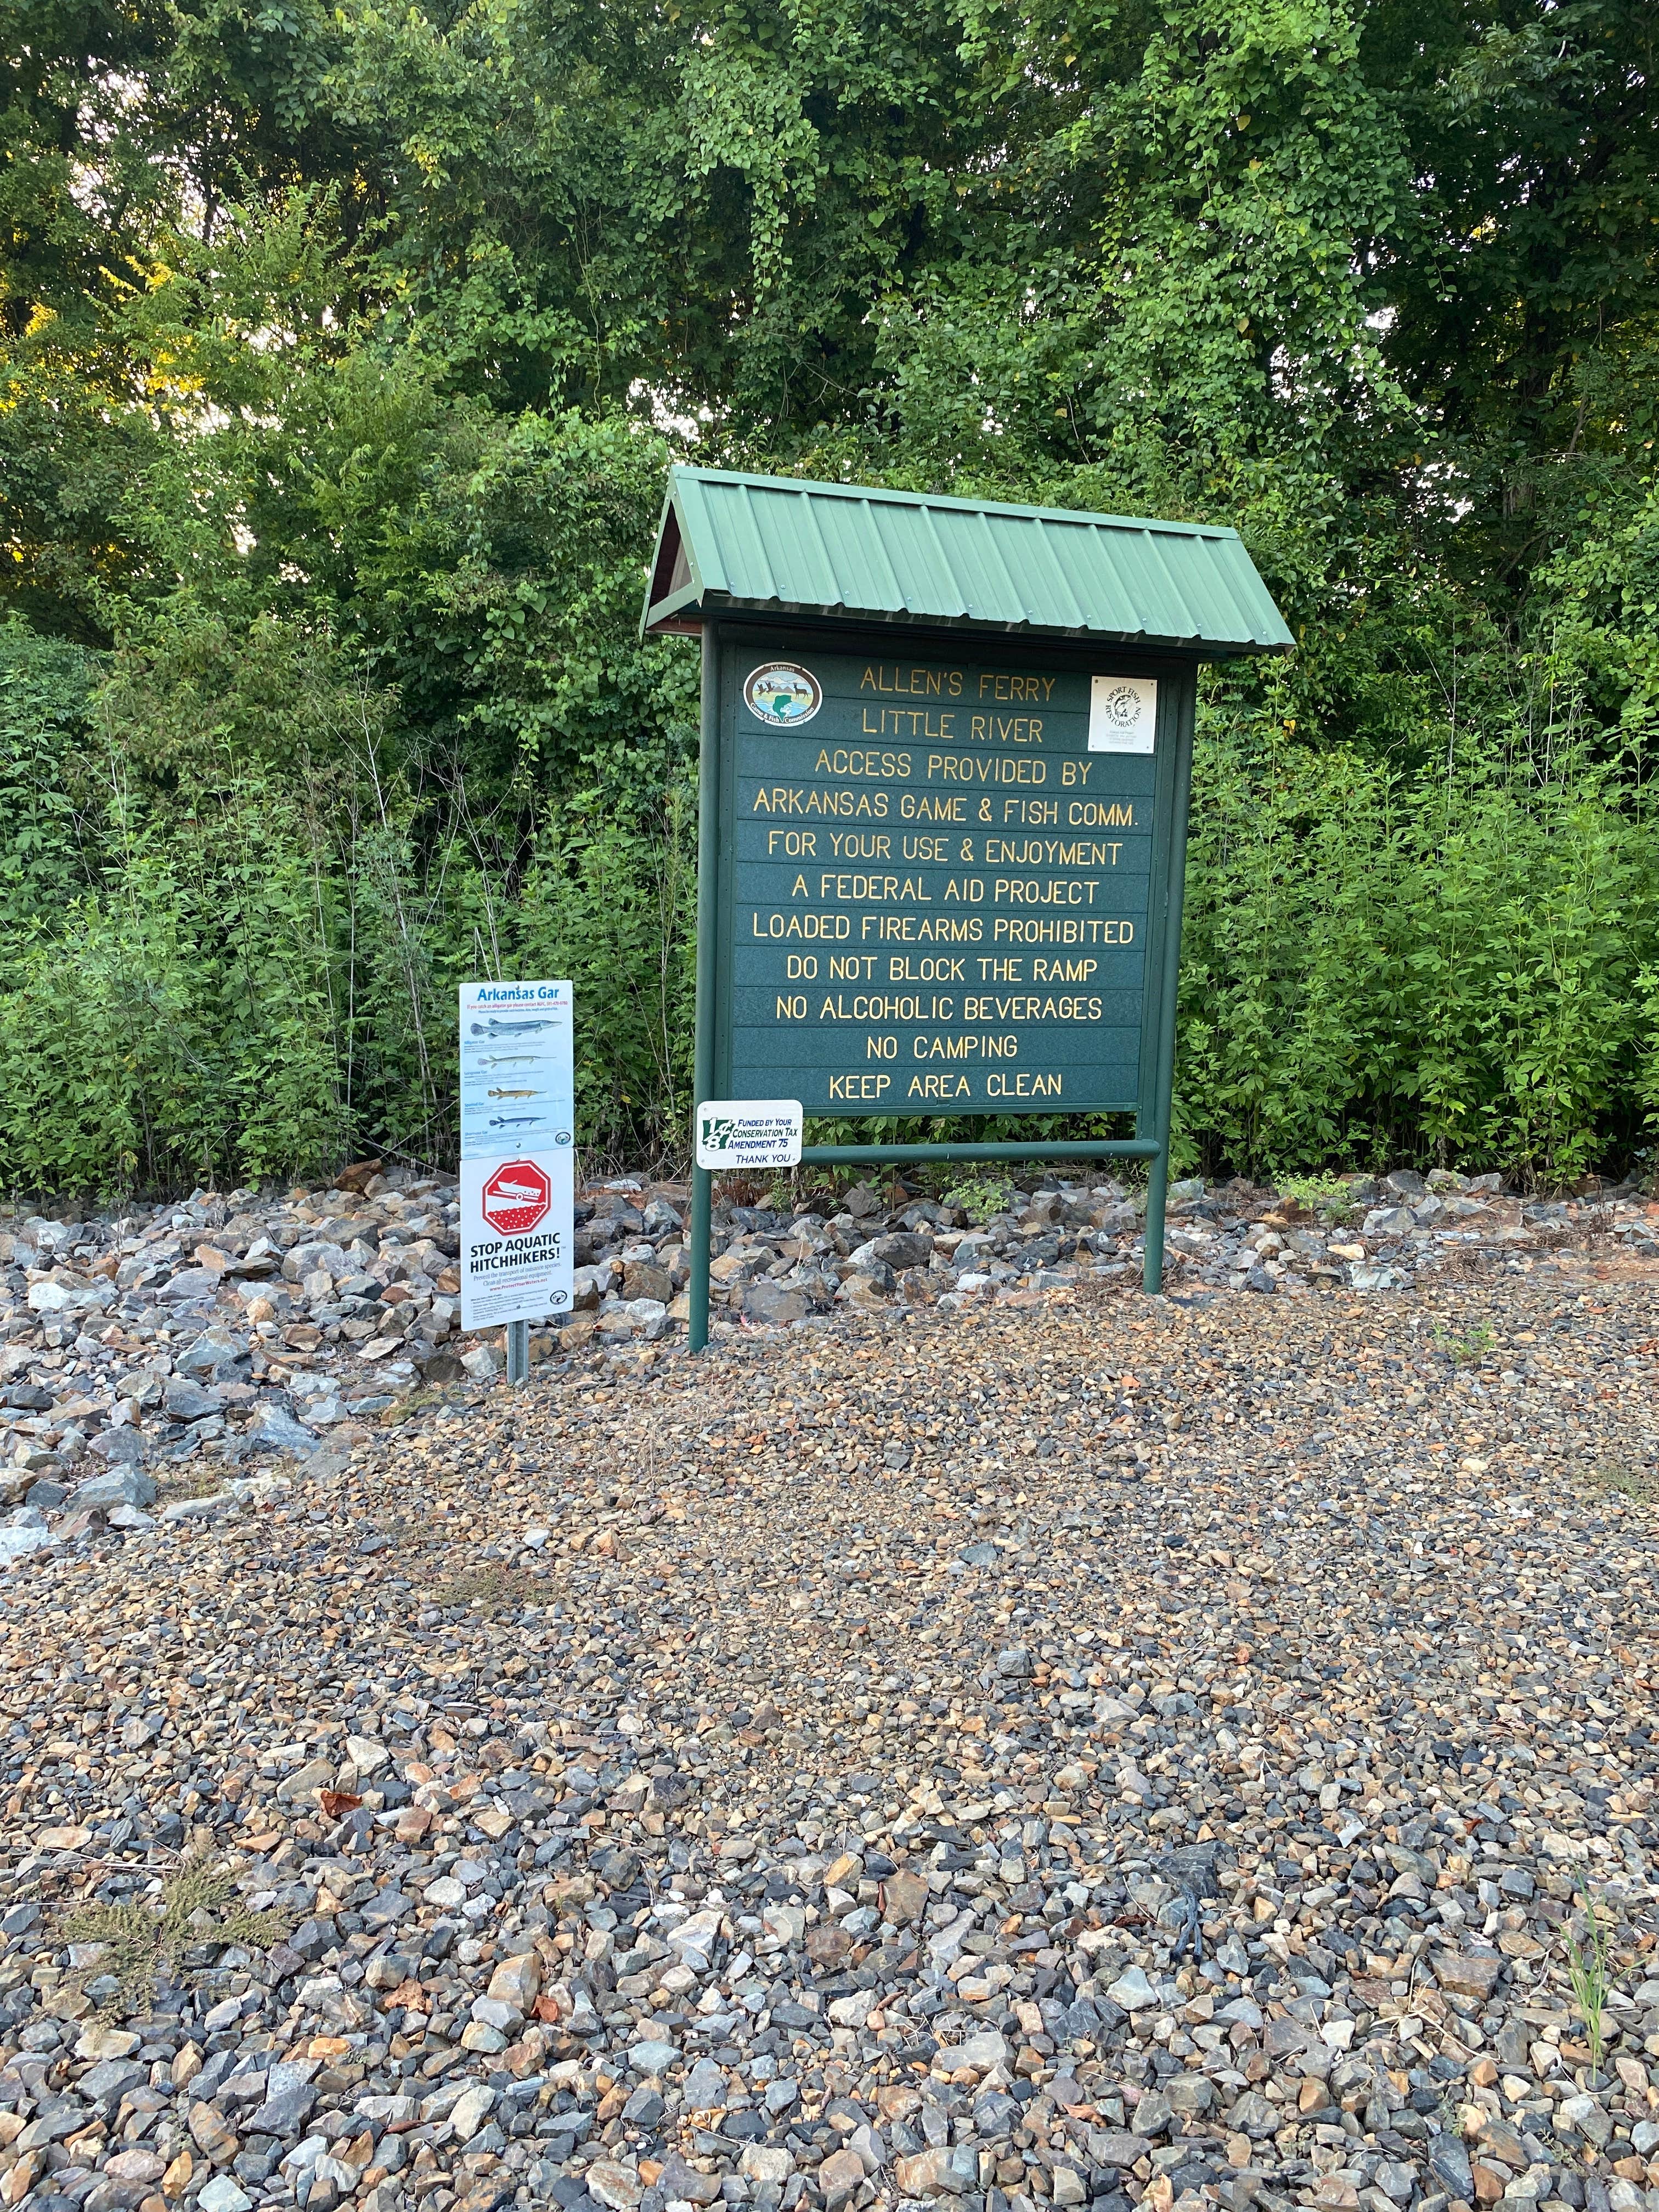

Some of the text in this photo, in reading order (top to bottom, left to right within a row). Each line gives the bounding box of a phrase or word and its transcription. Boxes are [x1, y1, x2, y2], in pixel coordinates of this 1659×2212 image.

[860, 666, 1056, 702] ALLEN'S FERRY
[1107, 686, 1141, 703] SPORT FISH
[751, 703, 764, 716] Game
[785, 707, 814, 723] Commission
[1105, 705, 1142, 727] RESTORATION
[862, 708, 1043, 743] LITTLE RIVER
[815, 749, 1092, 786] ACCESS PROVIDED BY
[753, 788, 1139, 827] ARKANSAS GAME & FISH COMM.
[769, 830, 1123, 865] FOR YOUR USE & ENJOYMENT
[792, 874, 1099, 905] A FEDERAL AID PROJECT
[753, 912, 1133, 944] LOADED FIREARMS PROHIBITED
[787, 955, 1097, 981] DO NOT BLOCK THE RAMP
[477, 986, 559, 1001] Arkansas Gar
[776, 995, 1102, 1020] NO ALCOHOLIC BEVERAGES
[867, 1035, 1017, 1059] NO CAMPING
[830, 1074, 1062, 1099] KEEP AREA CLEAN
[778, 1138, 788, 1148] 75
[736, 1154, 791, 1164] THANK YOU
[471, 1233, 561, 1257] STOP AQUATIC
[471, 1247, 560, 1273] HITCHHIKERS!
[490, 1278, 548, 1291] www.ProtectYourWaters.net
[499, 1269, 519, 1278] transport
[502, 1274, 528, 1284] recreational
